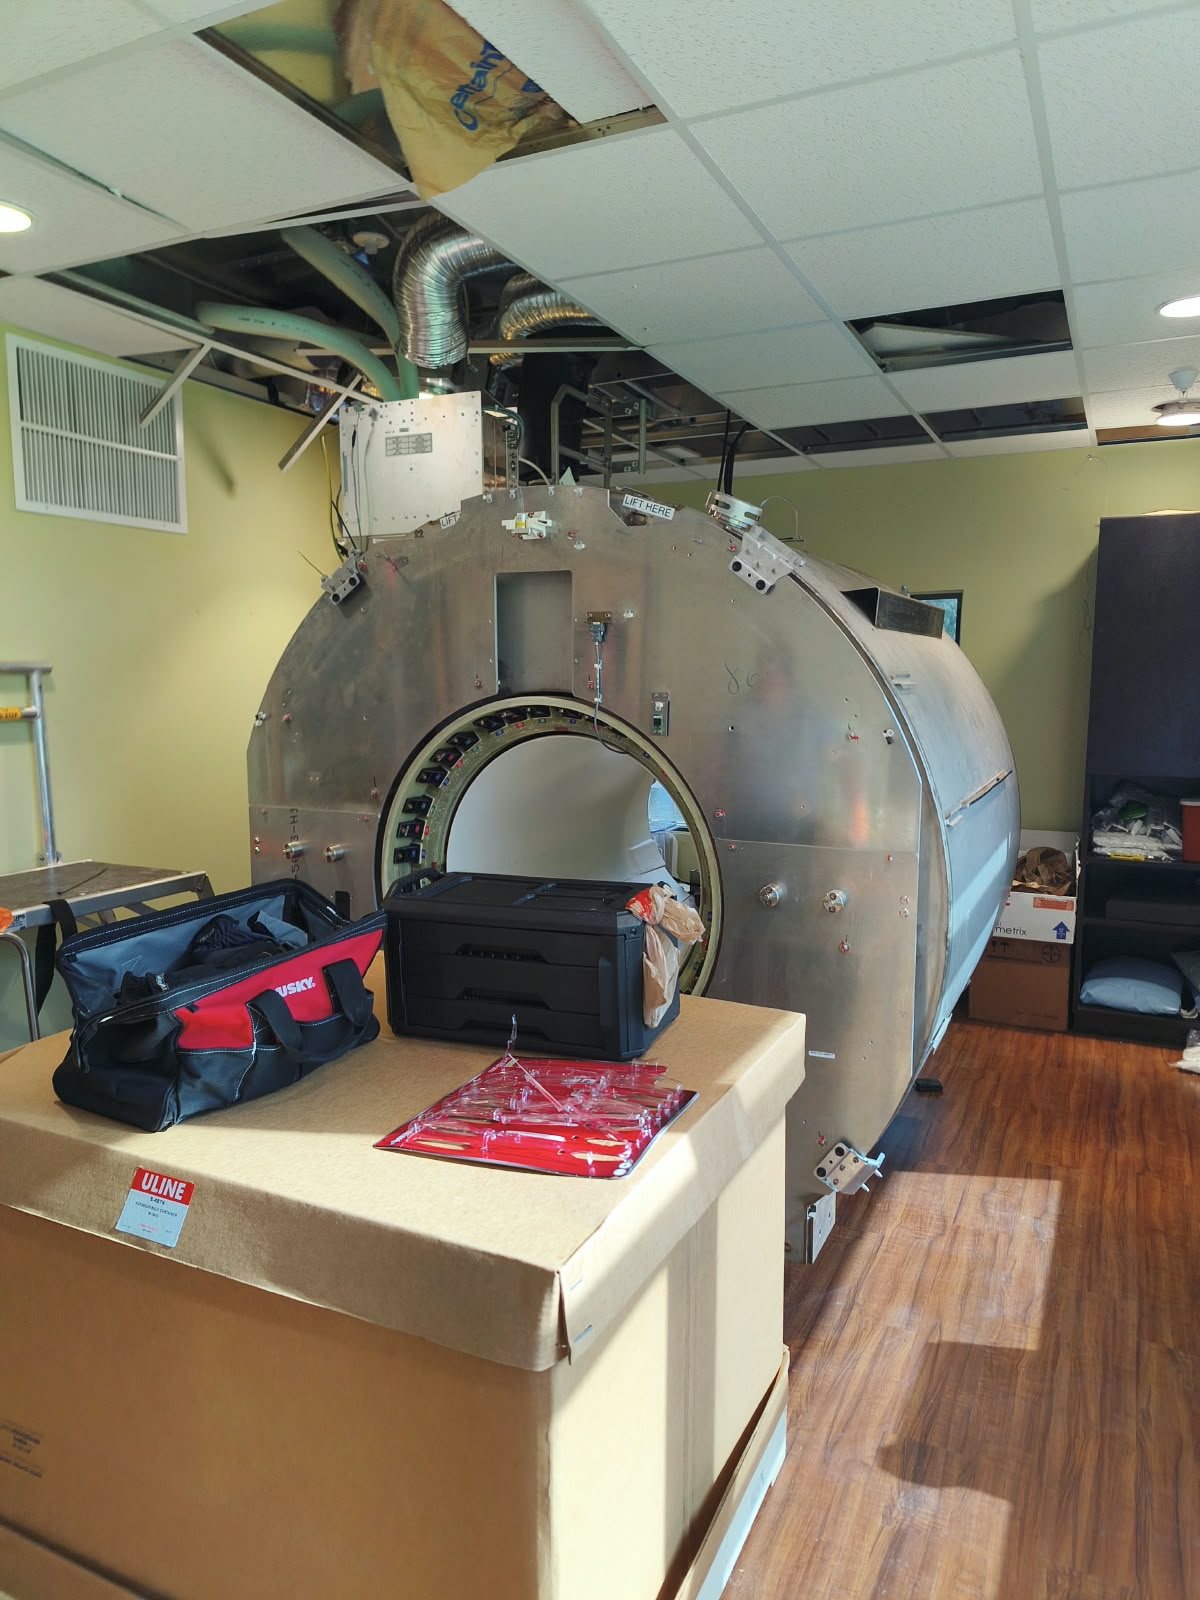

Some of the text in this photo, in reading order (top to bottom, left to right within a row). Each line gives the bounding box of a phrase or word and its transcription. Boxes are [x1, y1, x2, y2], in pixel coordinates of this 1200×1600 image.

[624, 495, 672, 518] LIFT HERE
[441, 514, 458, 527] LIFT
[275, 976, 314, 998] USKY
[141, 1172, 187, 1201] ULINE
